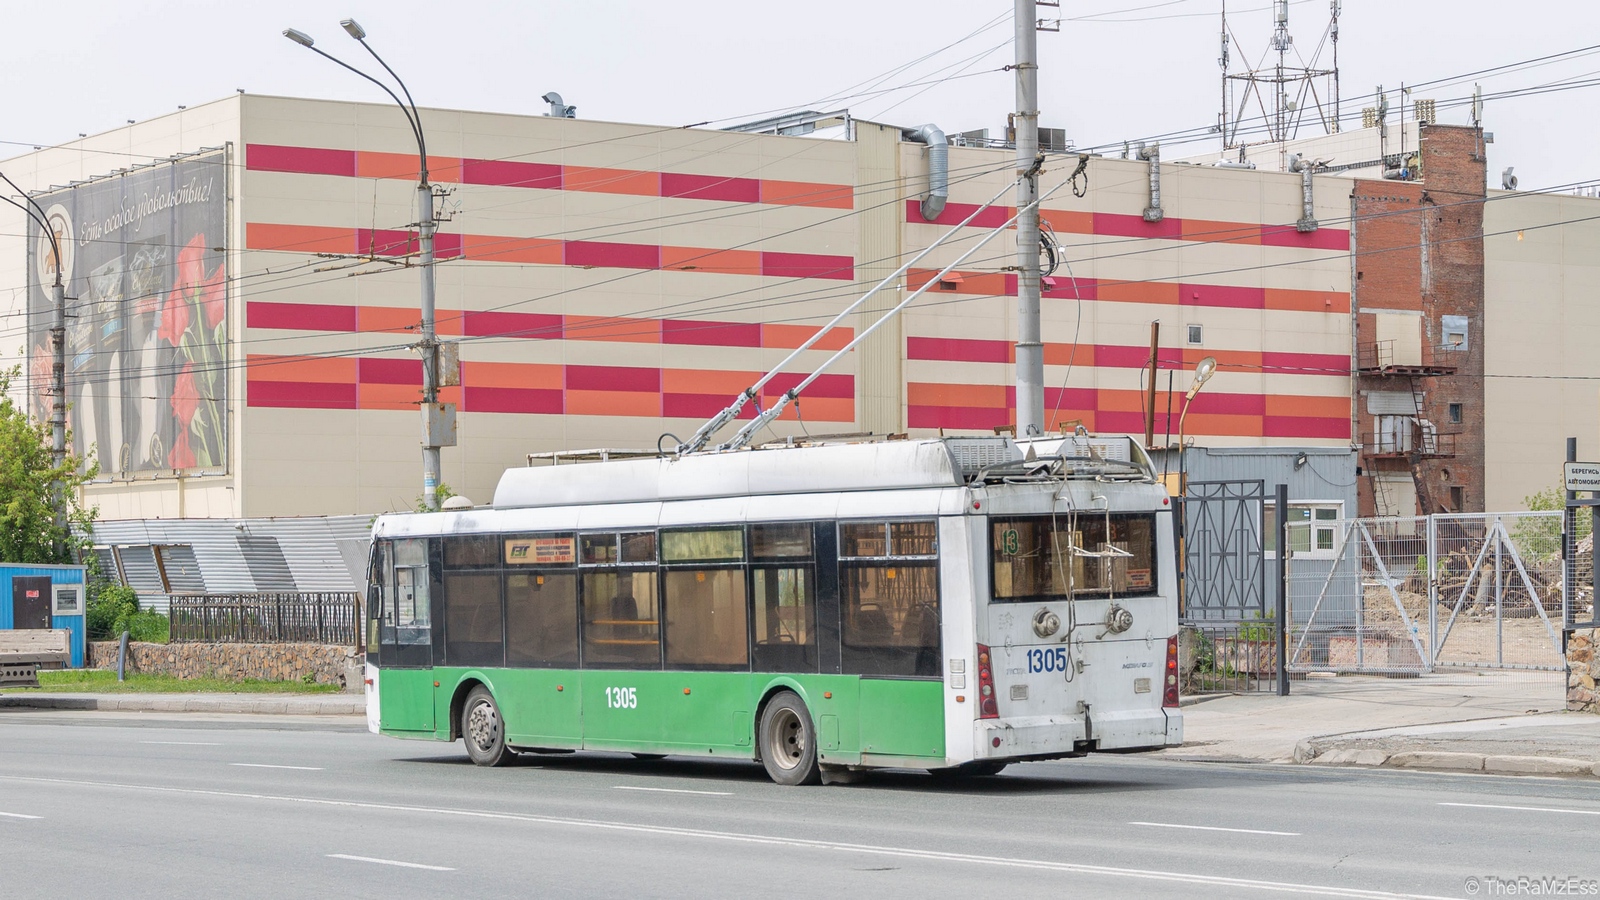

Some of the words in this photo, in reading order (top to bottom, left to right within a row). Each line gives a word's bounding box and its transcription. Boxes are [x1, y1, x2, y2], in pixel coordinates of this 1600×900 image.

[80, 220, 102, 247] Есть
[104, 195, 135, 235] особое
[135, 176, 213, 232] удовольствие!
[1002, 529, 1019, 555] 13
[1027, 647, 1066, 674] 1305
[605, 686, 638, 709] 1305
